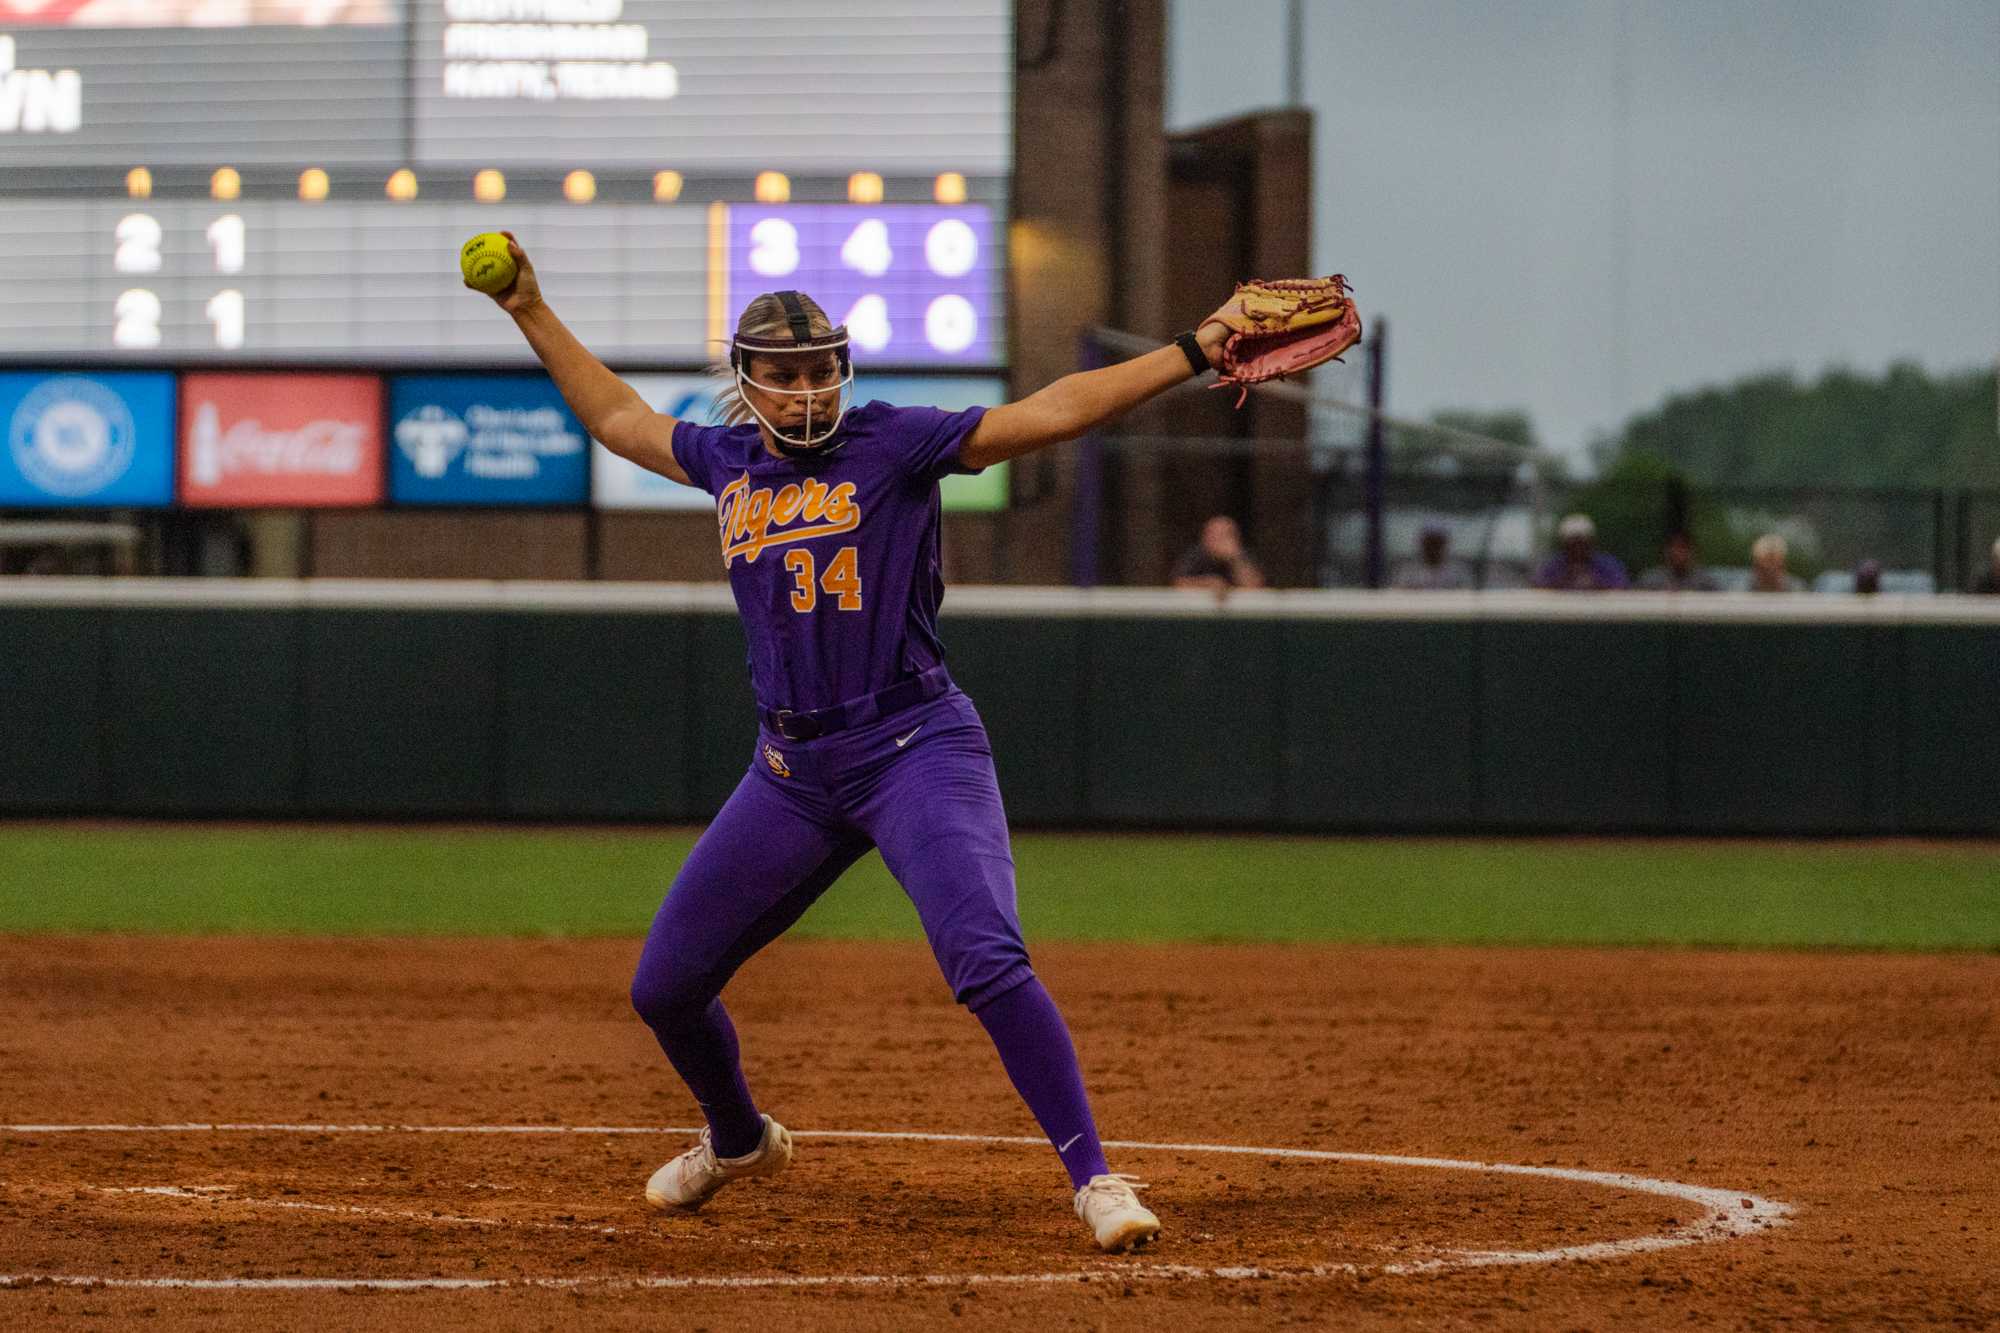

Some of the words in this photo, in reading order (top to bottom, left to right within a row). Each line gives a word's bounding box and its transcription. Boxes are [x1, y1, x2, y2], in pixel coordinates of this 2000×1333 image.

[114, 213, 161, 272] 2
[207, 214, 244, 273] 1
[750, 218, 799, 276] 3
[841, 219, 892, 277] 4
[925, 219, 978, 277] 0
[113, 288, 161, 349] 2
[206, 289, 244, 349] 1
[845, 294, 892, 353] 4
[925, 294, 978, 354] 0
[718, 470, 860, 569] Tigers
[784, 547, 862, 612] 34
